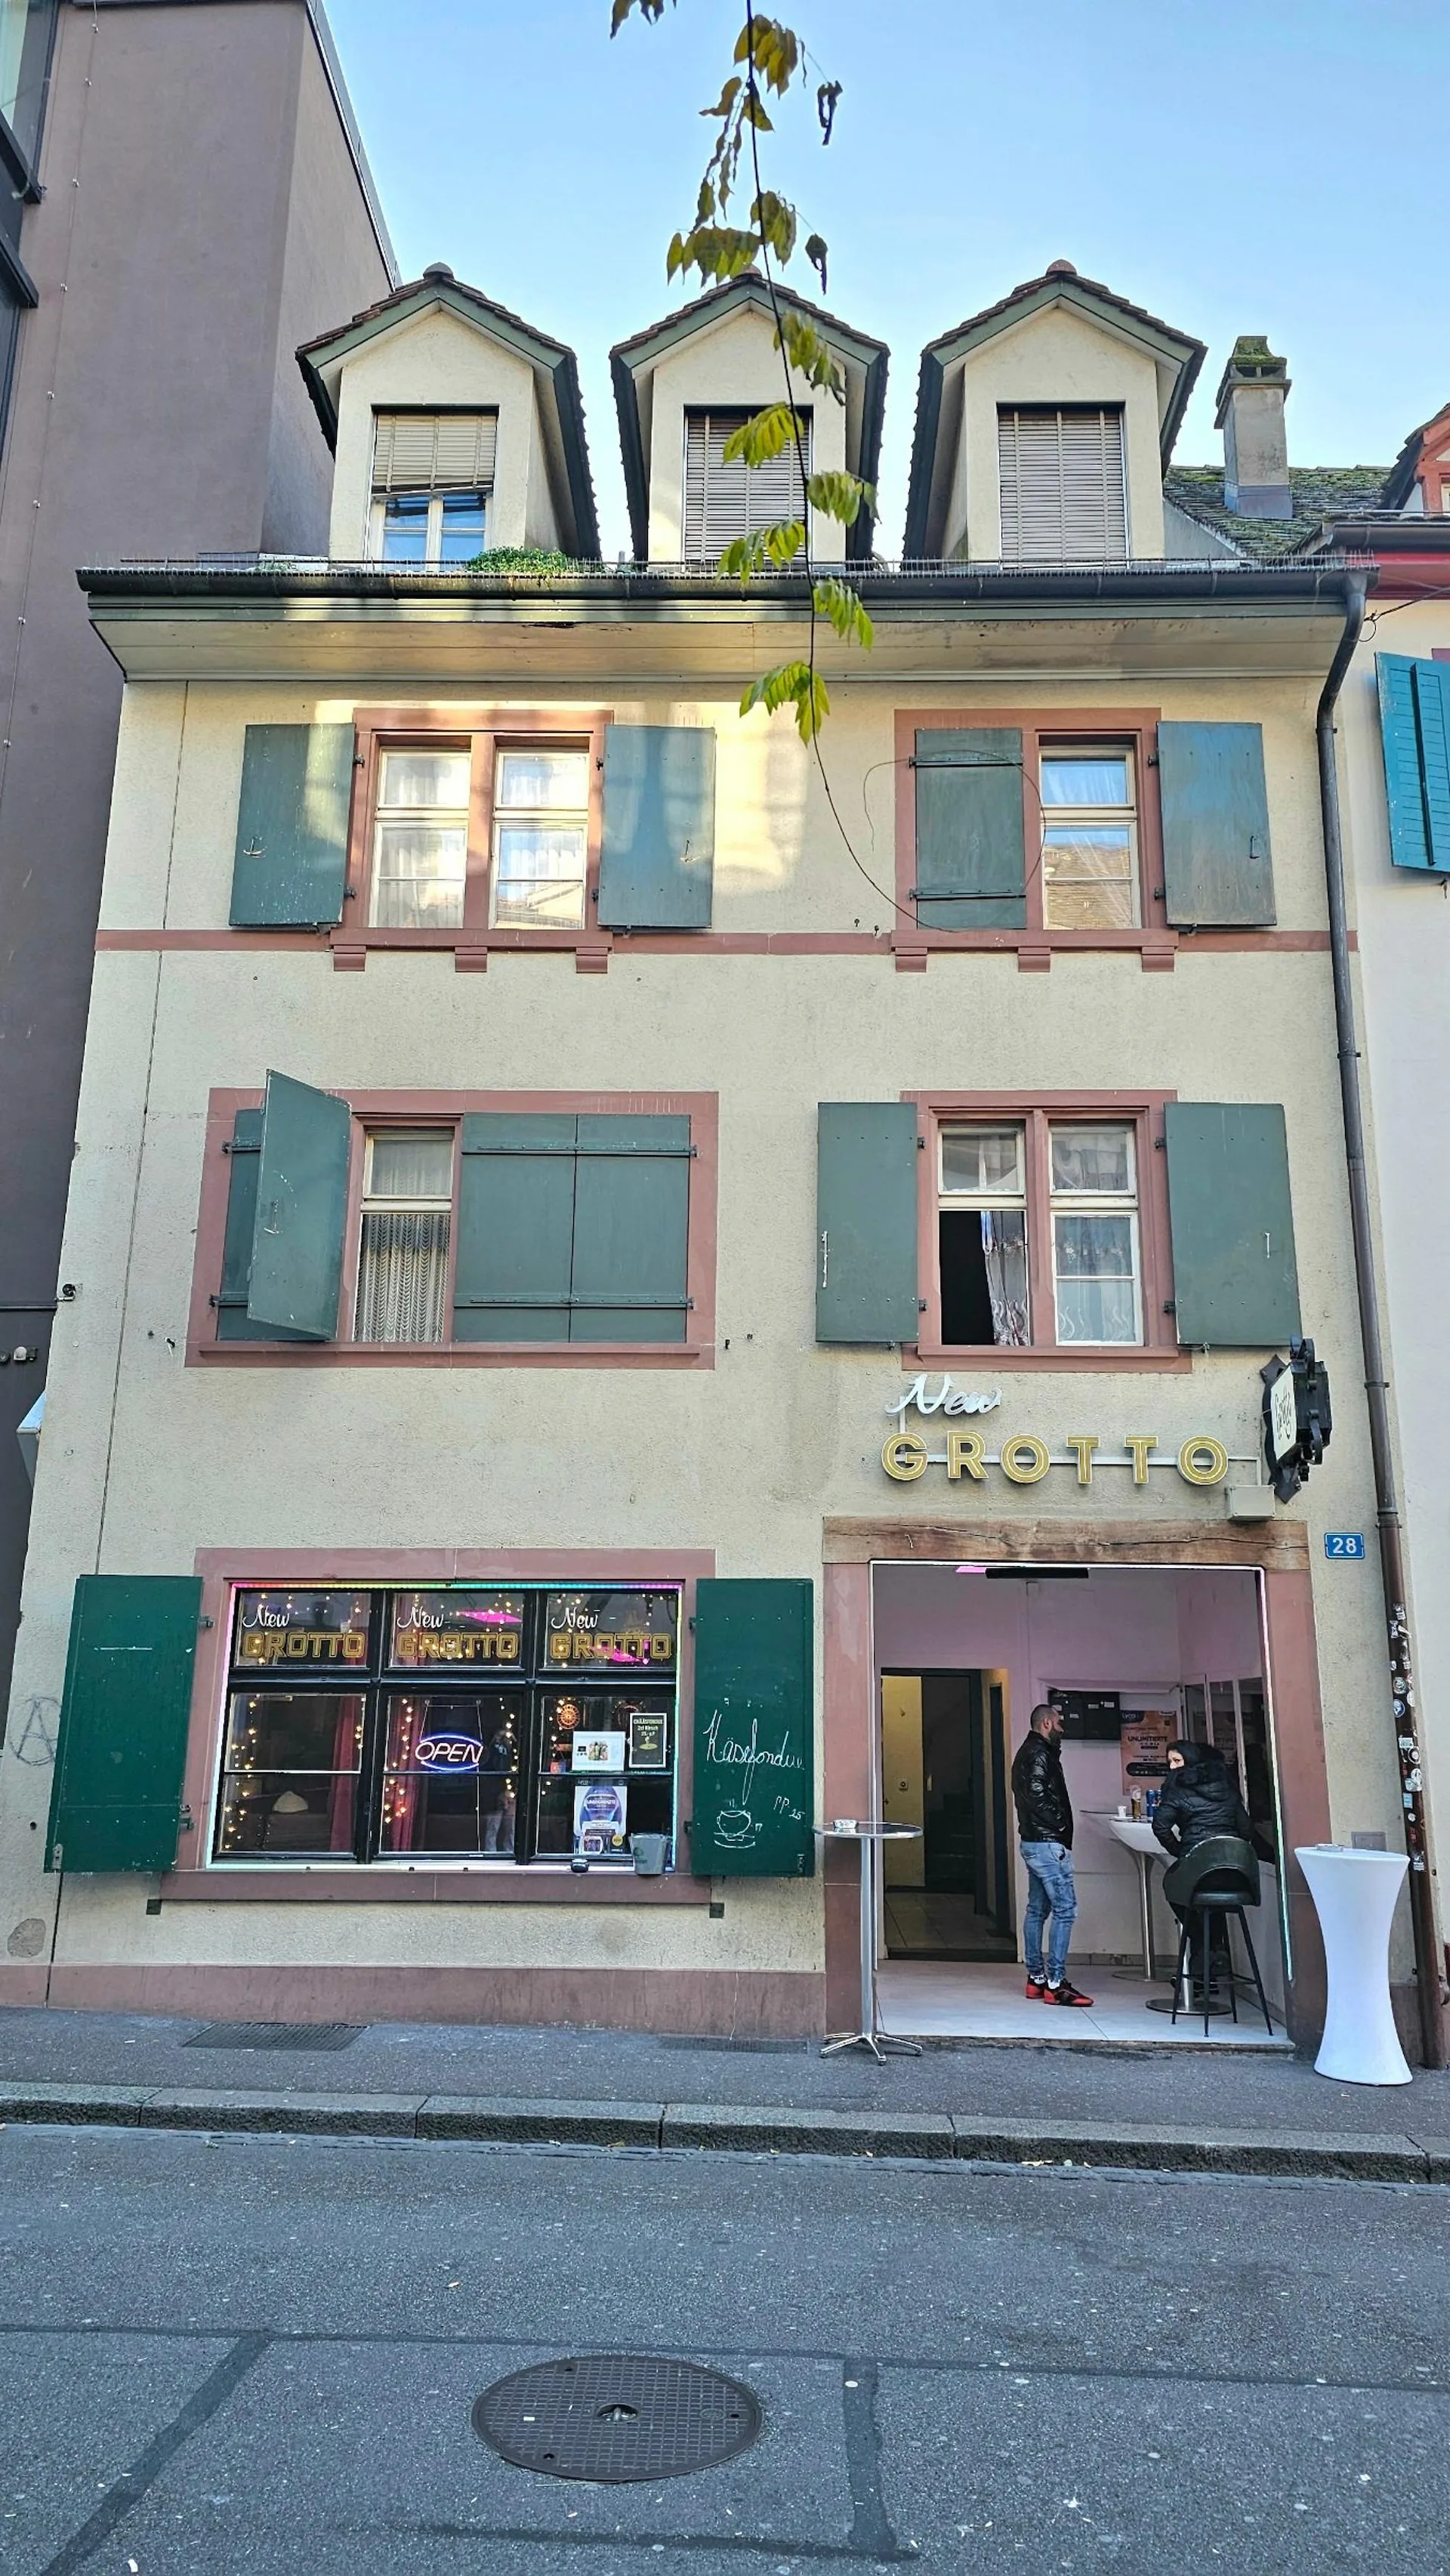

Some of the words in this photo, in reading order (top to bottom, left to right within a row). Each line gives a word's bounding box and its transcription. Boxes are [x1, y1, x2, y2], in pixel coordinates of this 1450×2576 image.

[884, 1373, 1003, 1416] New
[881, 1430, 1229, 1486] GROTTO
[1332, 1537, 1357, 1554] 28
[242, 1604, 290, 1628] New
[396, 1606, 444, 1629] New
[551, 1607, 598, 1629] New
[242, 1632, 366, 1658] GROTTO
[396, 1632, 519, 1659] GROTTO
[550, 1632, 672, 1660] GROTTO
[415, 1741, 484, 1763] OPEN
